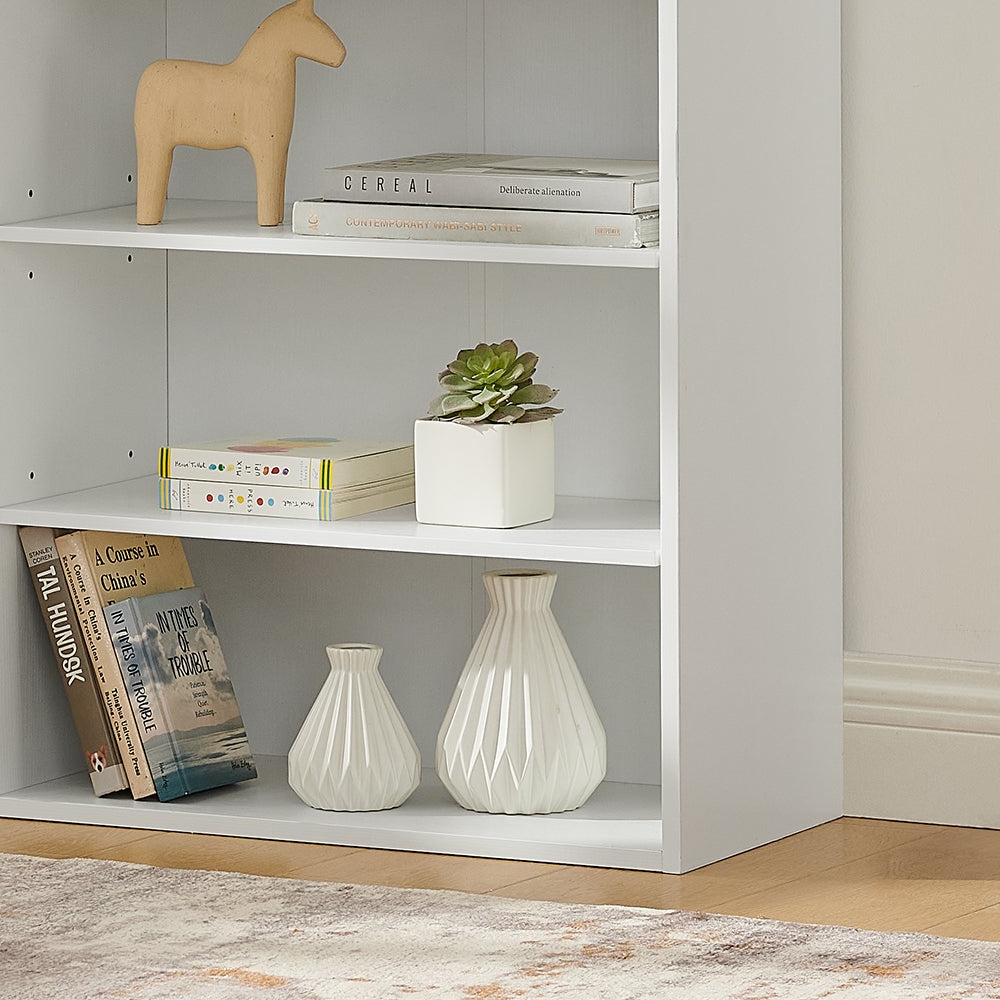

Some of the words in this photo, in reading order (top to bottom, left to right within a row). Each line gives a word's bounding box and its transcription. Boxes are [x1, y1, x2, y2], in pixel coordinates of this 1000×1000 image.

[344, 175, 432, 194] CEREAL
[499, 185, 540, 196] Deliberate
[541, 186, 581, 197] alienation
[345, 217, 430, 230] CONTEMPORARY
[490, 223, 523, 233] STYLE
[245, 465, 251, 474] IT
[28, 546, 54, 559] STANLEY
[32, 553, 54, 564] COREN
[95, 547, 105, 566] A
[105, 545, 145, 564] Course
[144, 540, 160, 557] in
[36, 565, 61, 600] TAL
[100, 569, 147, 592] China's
[73, 564, 86, 593] Course
[88, 609, 102, 641] China's
[110, 609, 125, 625] IN
[156, 611, 170, 634] IN
[168, 605, 198, 632] TIMES
[47, 602, 86, 686] HUNDSK
[83, 619, 99, 662] Protection
[97, 665, 106, 683] Law
[115, 626, 136, 661] TIMES
[177, 630, 191, 653] OF
[127, 663, 141, 678] OF
[168, 650, 213, 680] TROUBLE
[132, 679, 157, 734] TROUBLE
[112, 688, 124, 719] Tsinghua
[121, 720, 135, 756] University
[131, 757, 141, 776] Press
